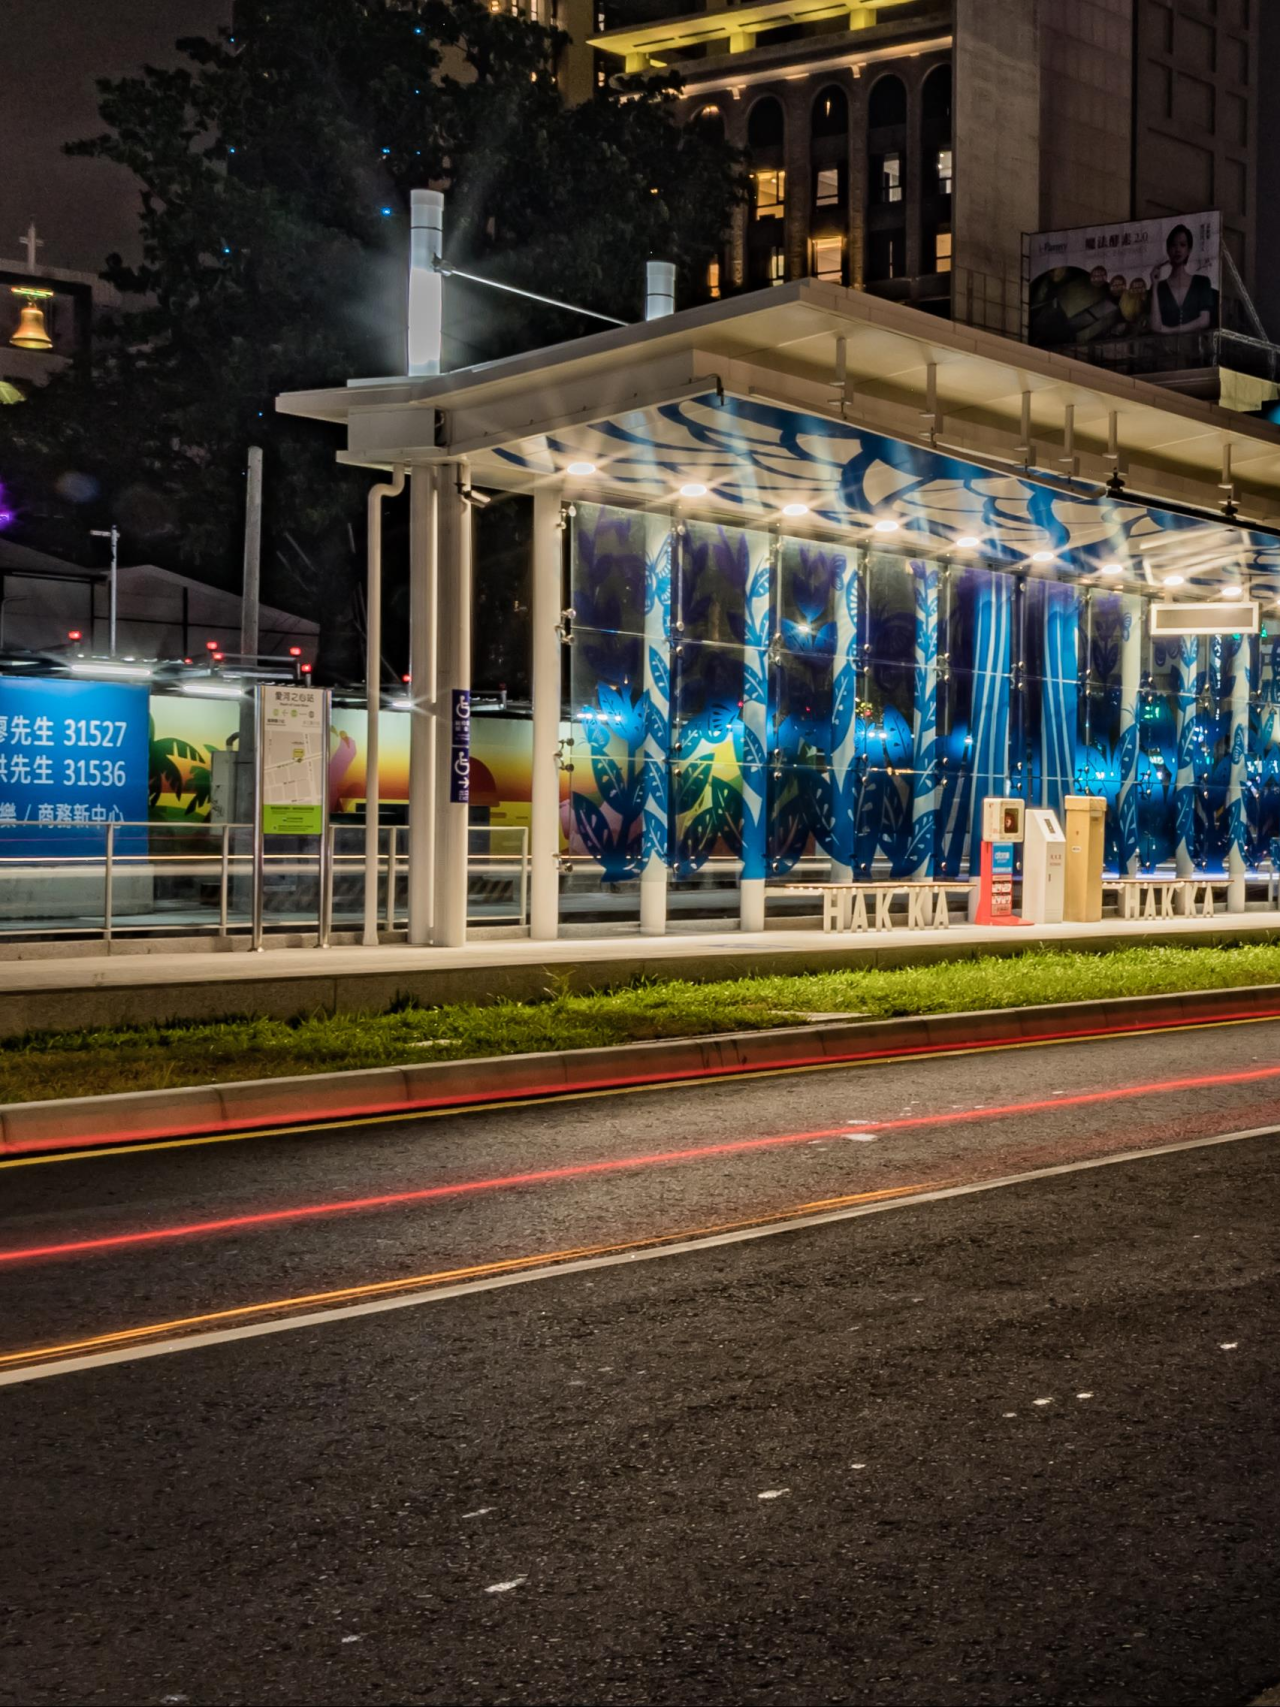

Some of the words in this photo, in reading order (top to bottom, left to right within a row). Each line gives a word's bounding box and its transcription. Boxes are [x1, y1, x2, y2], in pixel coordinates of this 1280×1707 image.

[1134, 230, 1149, 244] 2.0
[63, 719, 127, 747] 31527
[63, 759, 126, 787] 31536
[38, 803, 125, 829] 商務新中心
[822, 887, 950, 934] HAKKA
[1124, 882, 1215, 920] HAKKA
